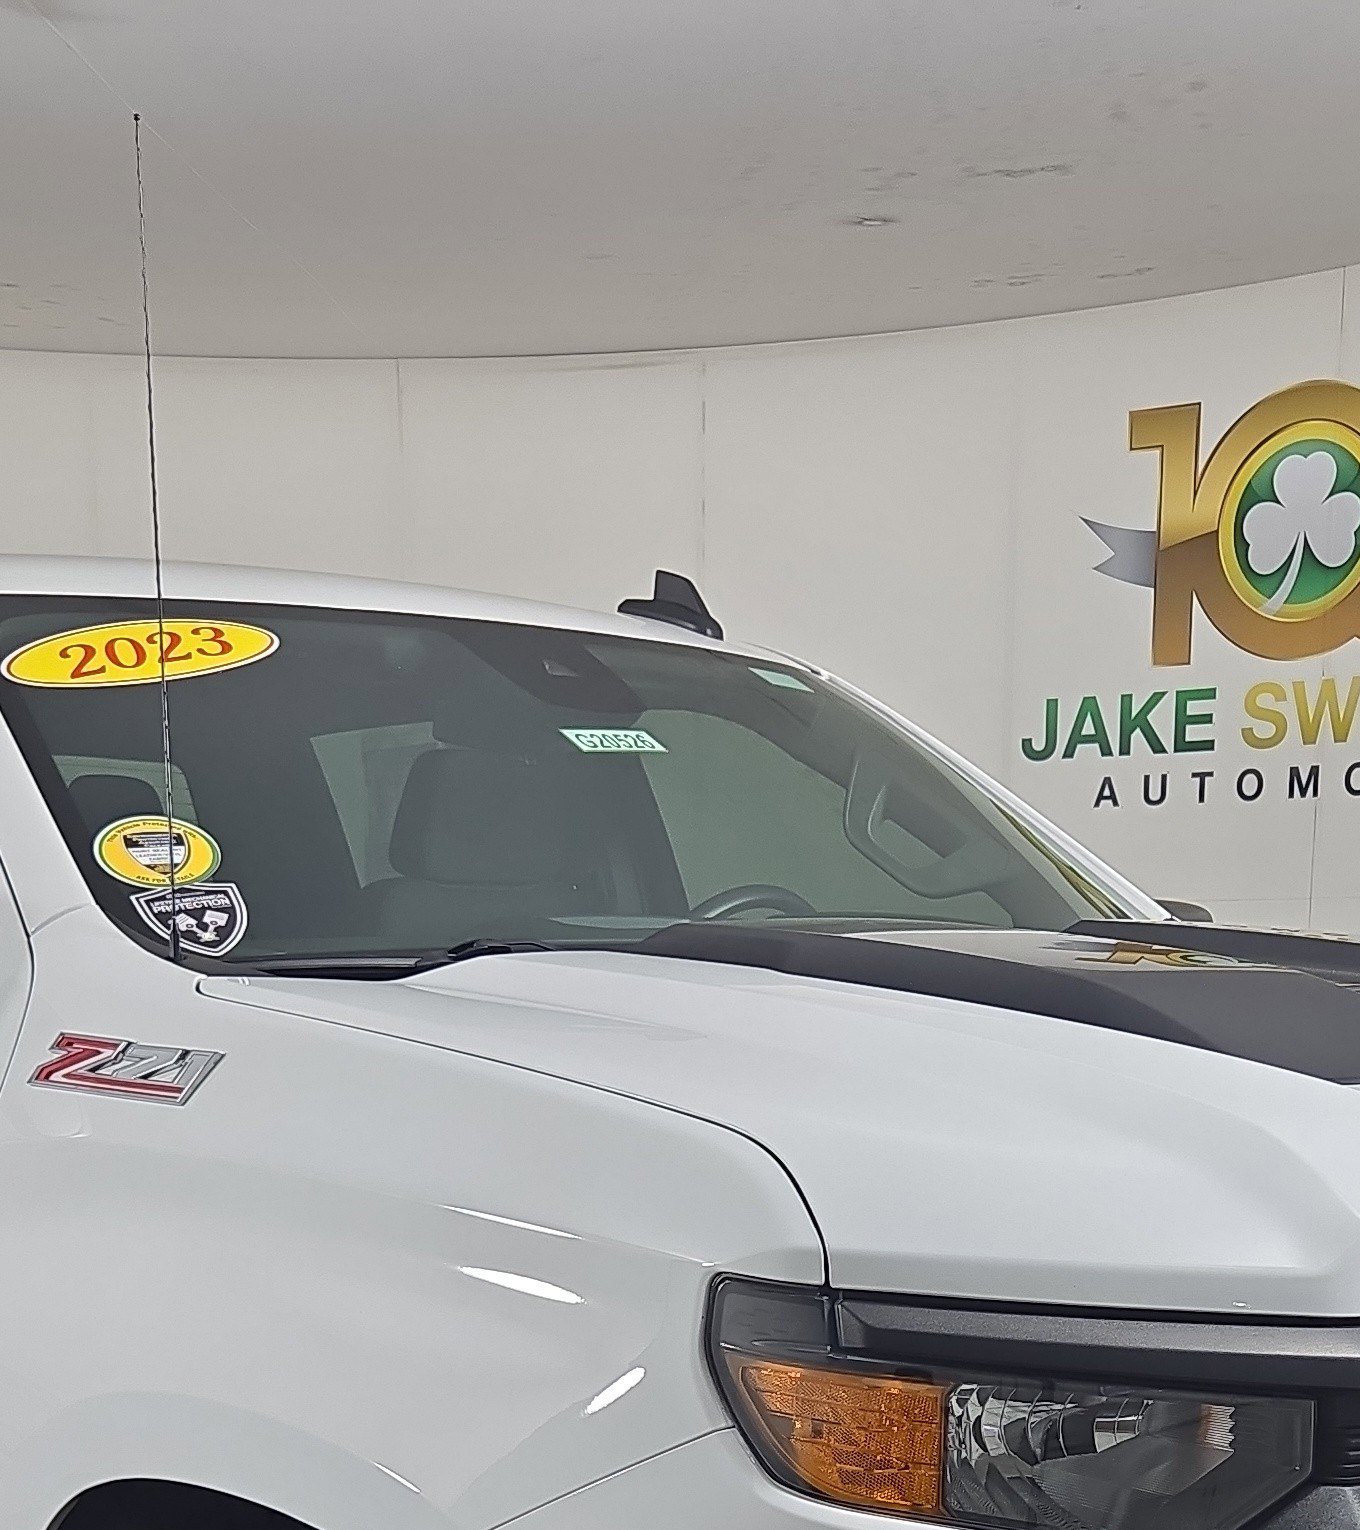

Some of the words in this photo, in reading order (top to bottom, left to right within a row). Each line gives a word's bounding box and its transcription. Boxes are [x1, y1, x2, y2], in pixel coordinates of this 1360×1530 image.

[58, 626, 234, 680] 2023
[1020, 686, 1218, 765] JAKE
[152, 898, 232, 914] PROTECTION
[26, 1031, 226, 1107] Z71
